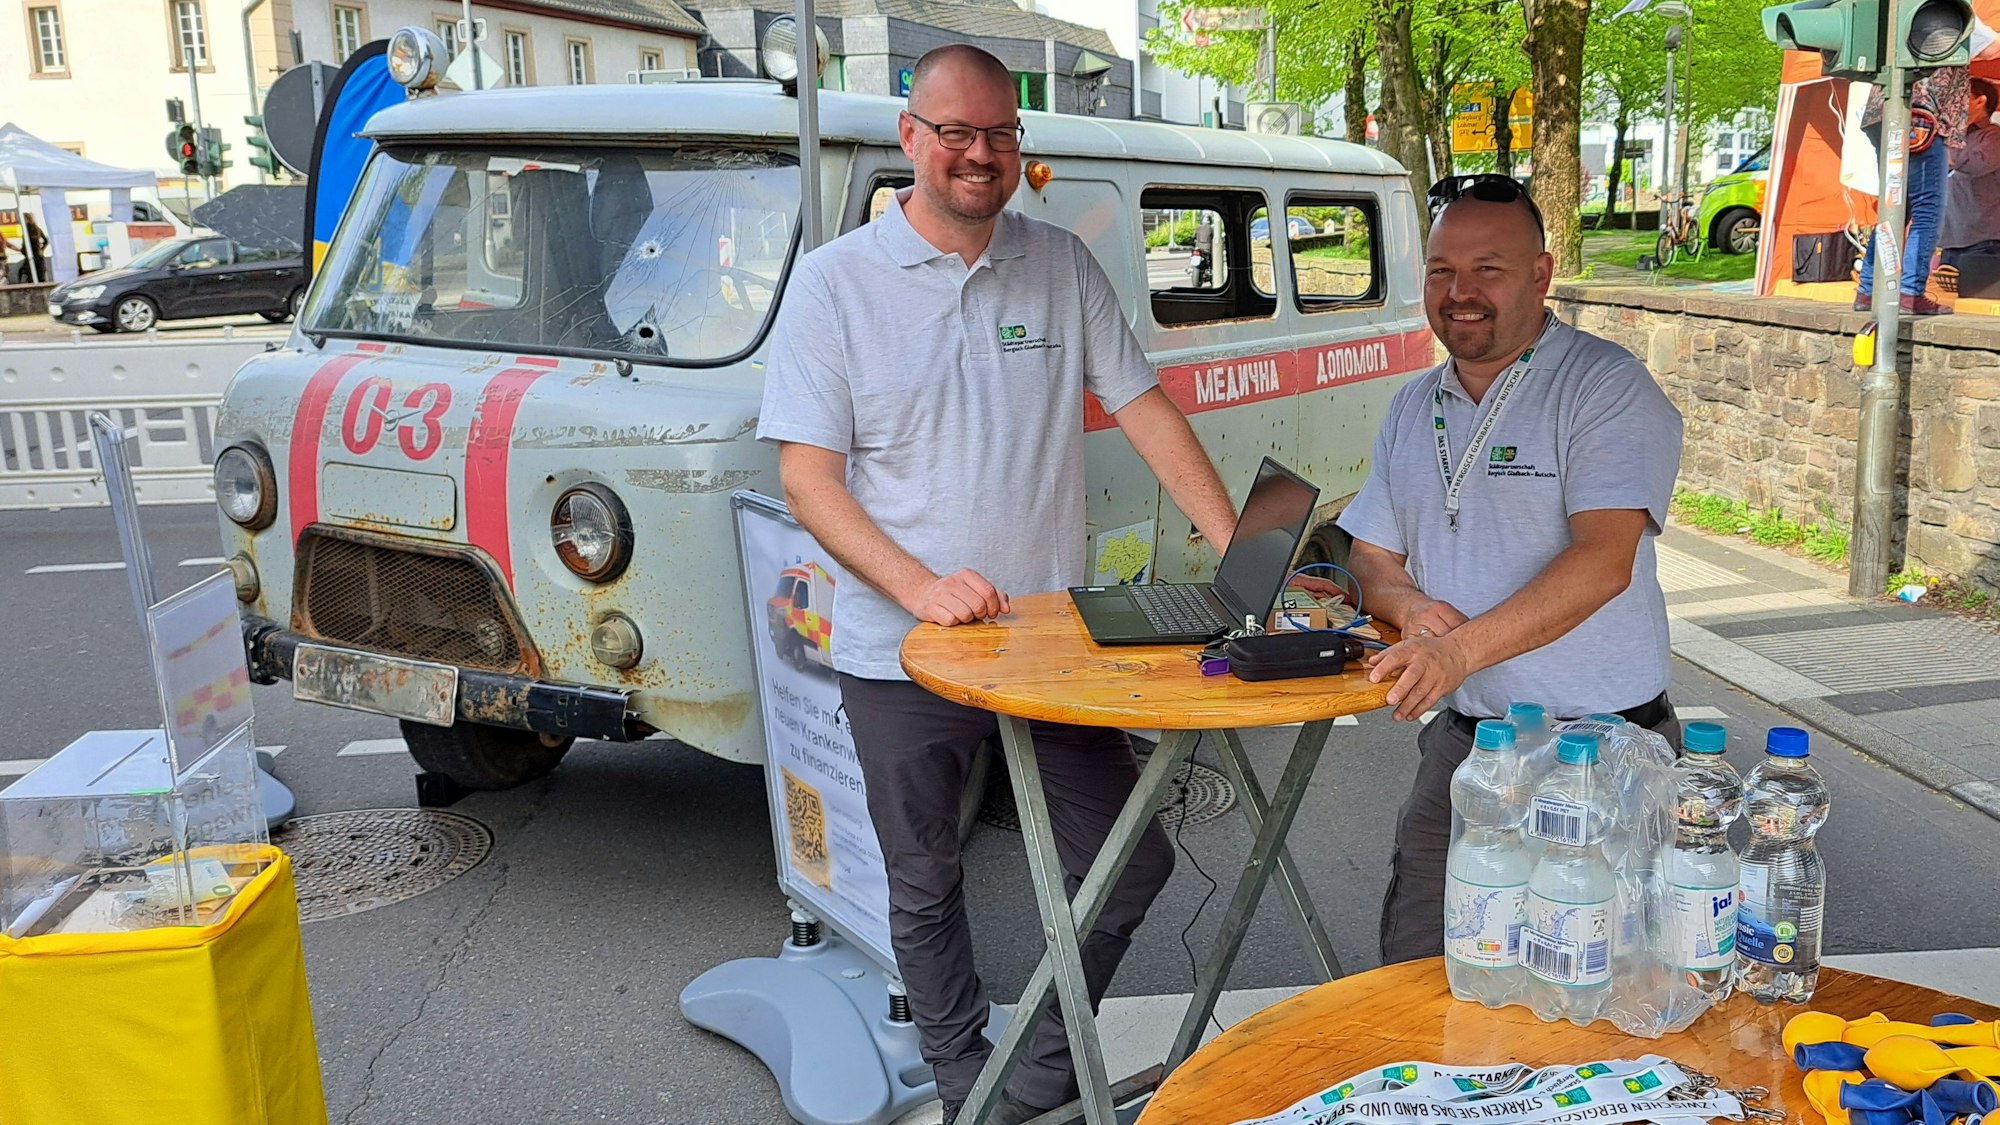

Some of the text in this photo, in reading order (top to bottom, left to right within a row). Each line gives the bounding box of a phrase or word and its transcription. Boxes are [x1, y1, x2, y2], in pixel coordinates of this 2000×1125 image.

[1195, 342, 1389, 404] МЕДИЧНА ДОПОМОГА
[342, 376, 453, 461] 03
[1455, 369, 1522, 487] BERGISCH GLADBACH UND BUTSCHA
[1437, 435, 1445, 448] DAS
[1438, 449, 1450, 474] STARKE
[772, 678, 801, 711] Helfen
[803, 696, 820, 719] Sie
[775, 706, 862, 768] neuen Krankenw
[789, 743, 865, 795] zu finanzieren
[1712, 891, 1732, 918] ja!
[1738, 922, 1755, 935] ssic
[1738, 930, 1765, 949] Quelle
[1545, 1073, 1575, 1092] Bergisch
[1360, 1102, 1391, 1116] UND
[1394, 1102, 1429, 1116] BAND
[1432, 1104, 1455, 1118] DAS
[1459, 1107, 1480, 1119] SIE
[1483, 1096, 1543, 1116] STÄRKEN
[1633, 1101, 1712, 1113] ZWISCHEN
